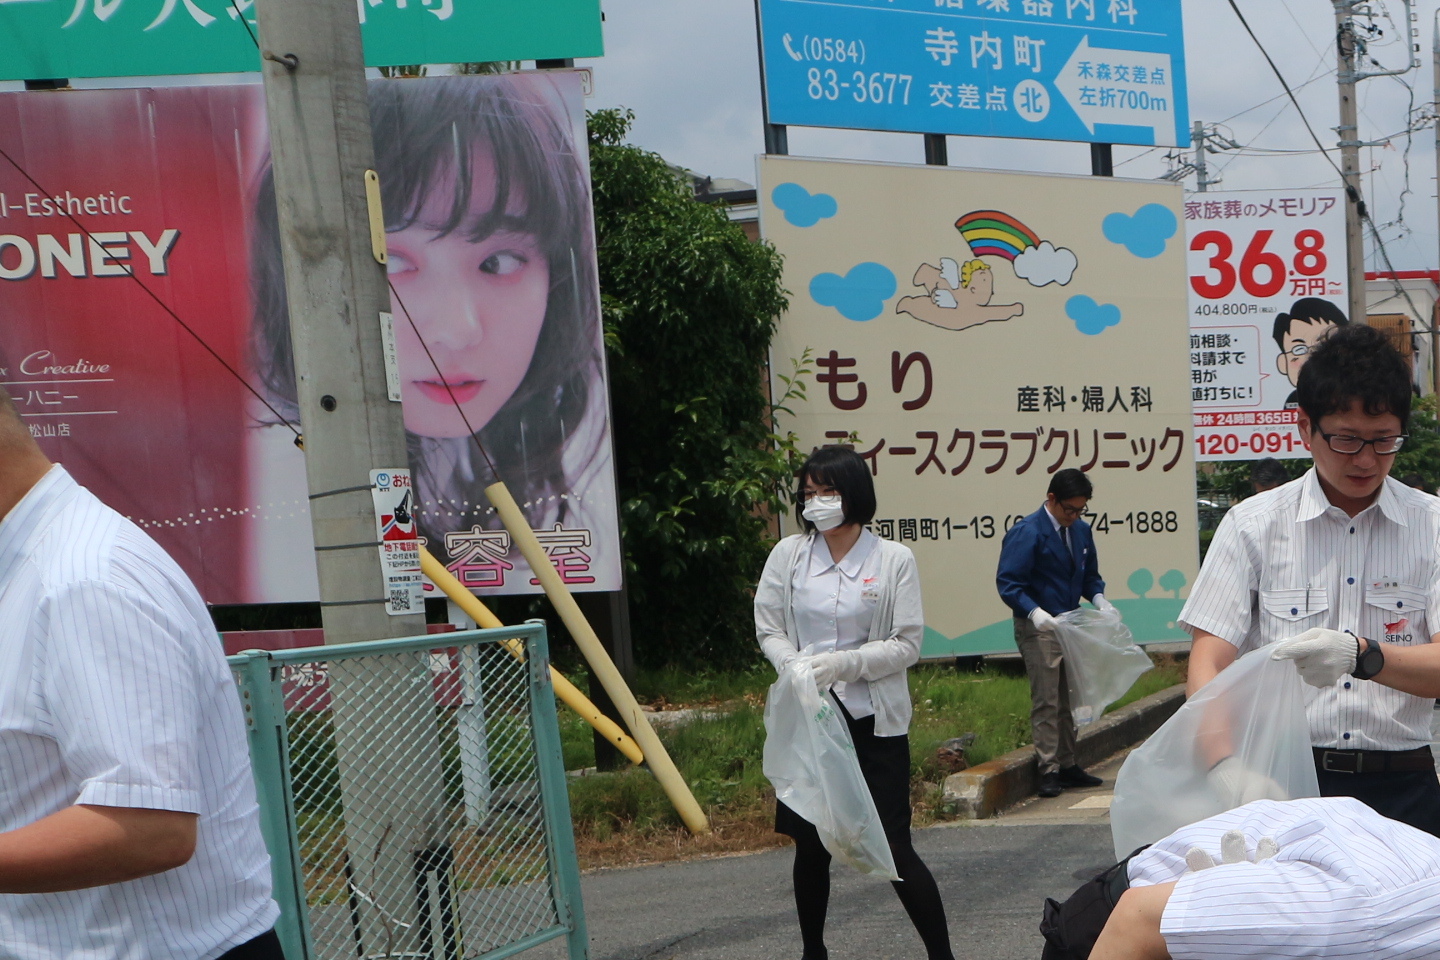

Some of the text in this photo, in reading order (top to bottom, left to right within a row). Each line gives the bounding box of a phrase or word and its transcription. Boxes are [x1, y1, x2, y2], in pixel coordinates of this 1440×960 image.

[935, 0, 1138, 25] 器内科
[803, 35, 866, 65] (0584)
[924, 27, 1046, 73] 寺内町
[807, 68, 913, 105] 83-3677
[1077, 61, 1165, 85] 禾森交差点
[929, 82, 1042, 113] 交差点 北
[1078, 85, 1168, 112] 左折700m
[1185, 197, 1336, 220] 家族葬のメモリア
[1189, 229, 1327, 300] 36.8
[1195, 303, 1257, 316] 404,800円
[20, 350, 110, 376] Creative
[816, 350, 933, 410] もり
[1017, 386, 1152, 413] 産科・婦人科
[420, 523, 596, 588] 容室
[1385, 634, 1413, 643] SEINO
